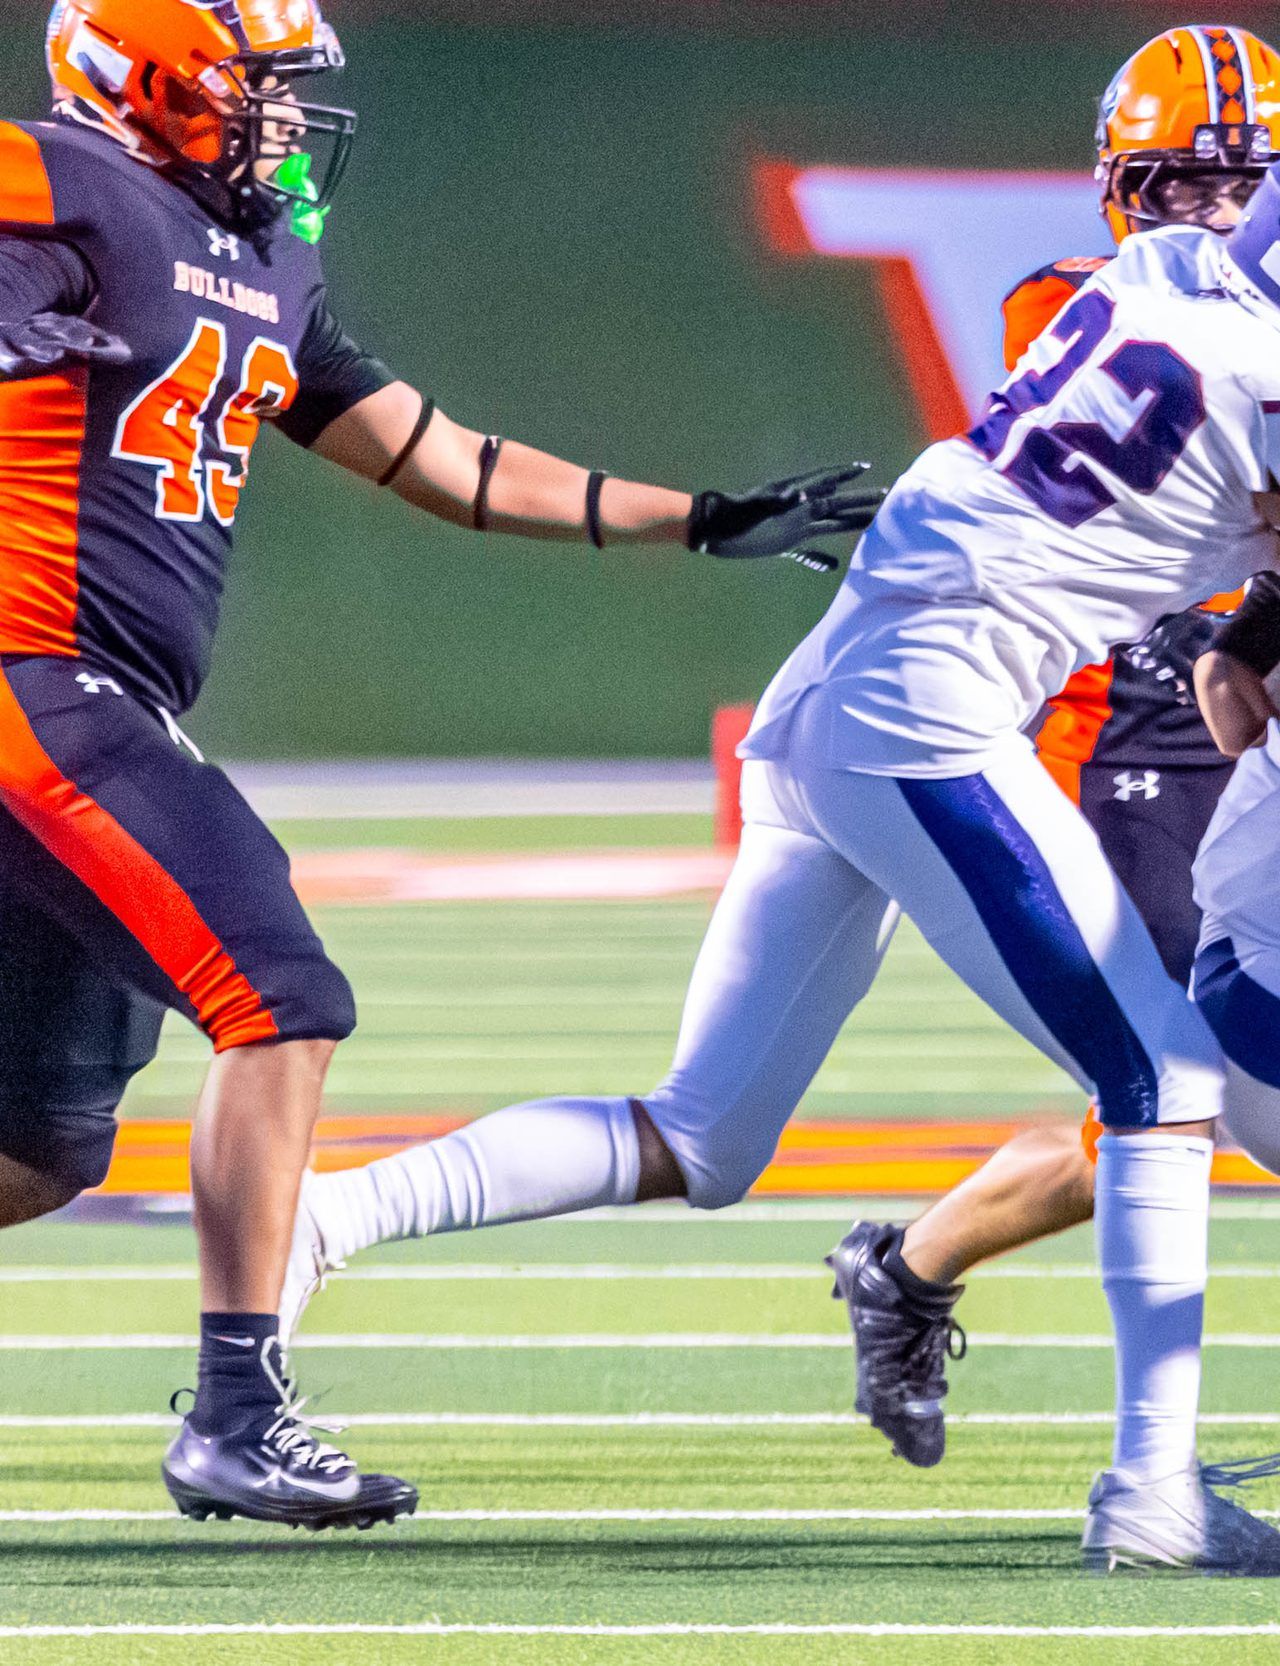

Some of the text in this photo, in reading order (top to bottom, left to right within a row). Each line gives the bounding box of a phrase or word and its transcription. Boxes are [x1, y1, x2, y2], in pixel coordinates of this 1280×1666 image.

[173, 260, 280, 324] BULLDOGS
[109, 316, 299, 527] 49
[966, 287, 1207, 530] 22
